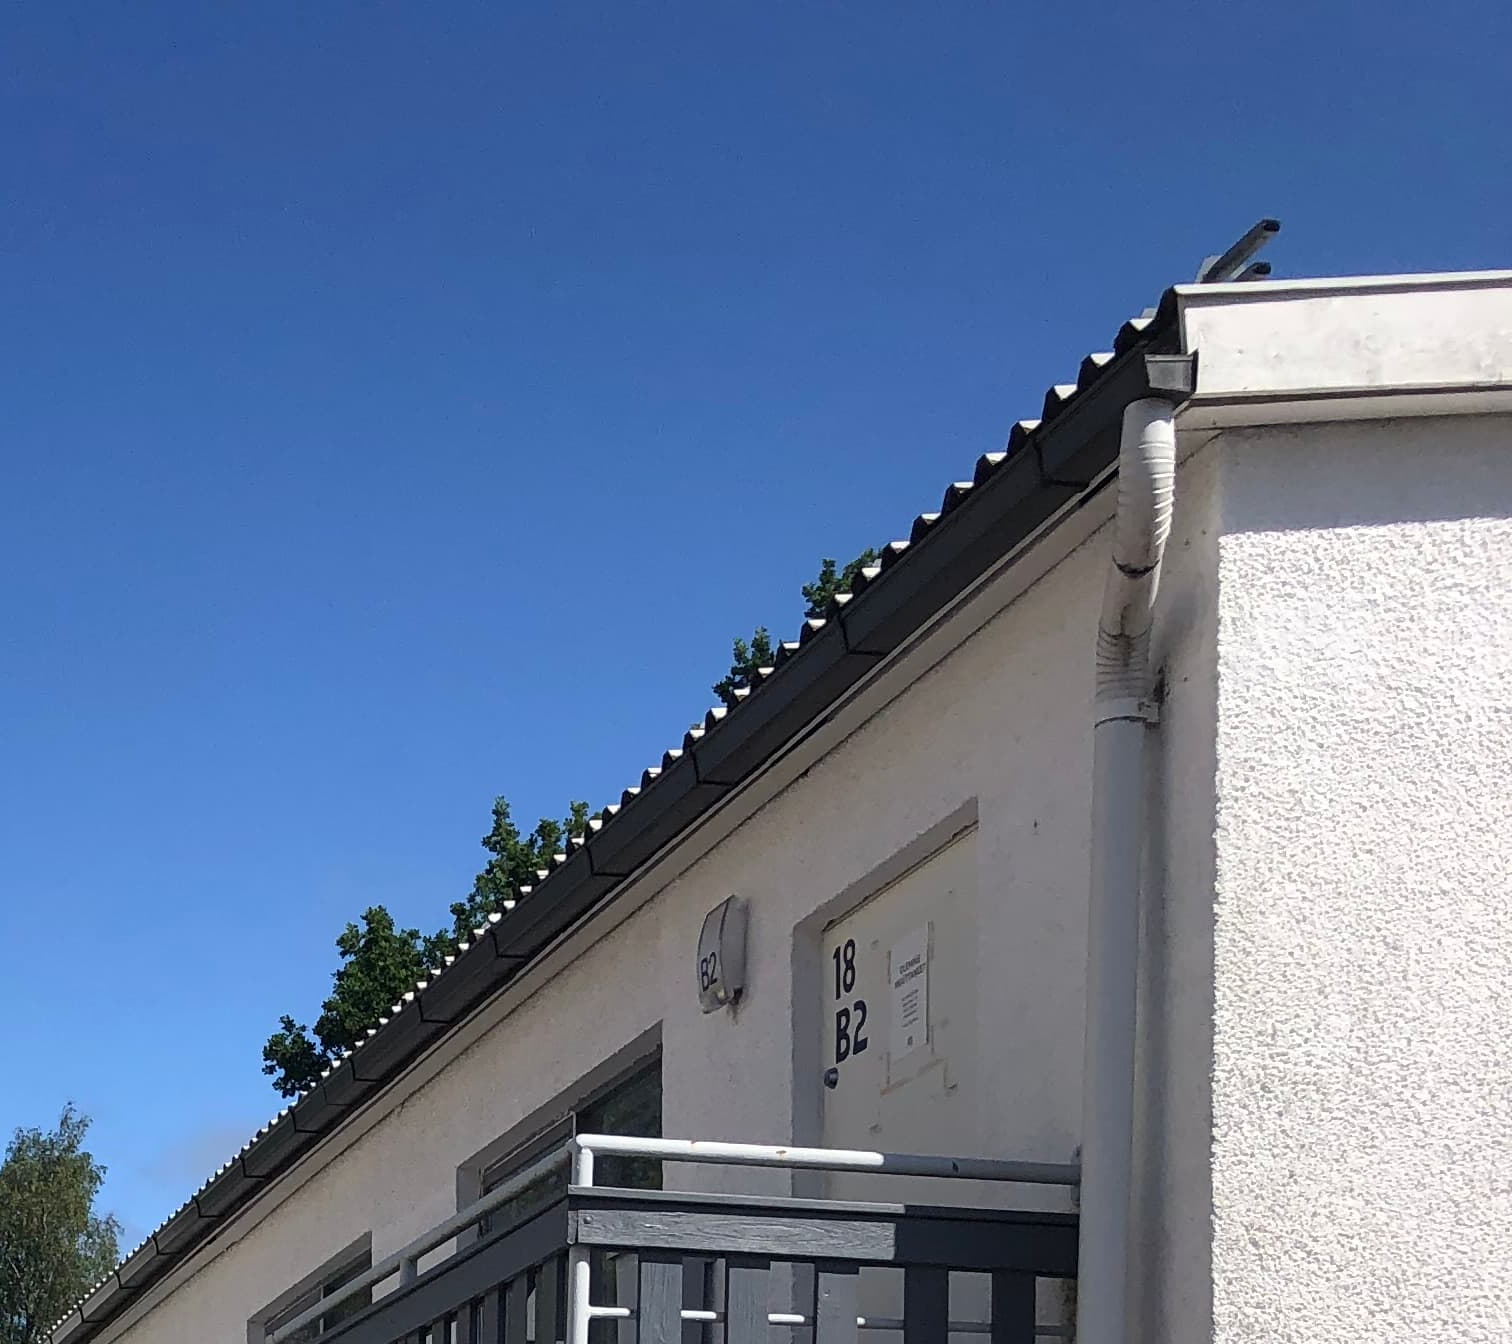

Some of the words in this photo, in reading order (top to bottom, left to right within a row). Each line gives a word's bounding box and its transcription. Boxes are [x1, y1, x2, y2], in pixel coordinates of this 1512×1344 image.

[700, 952, 717, 992] B2
[833, 939, 856, 1000] 18
[836, 1000, 868, 1064] B2
